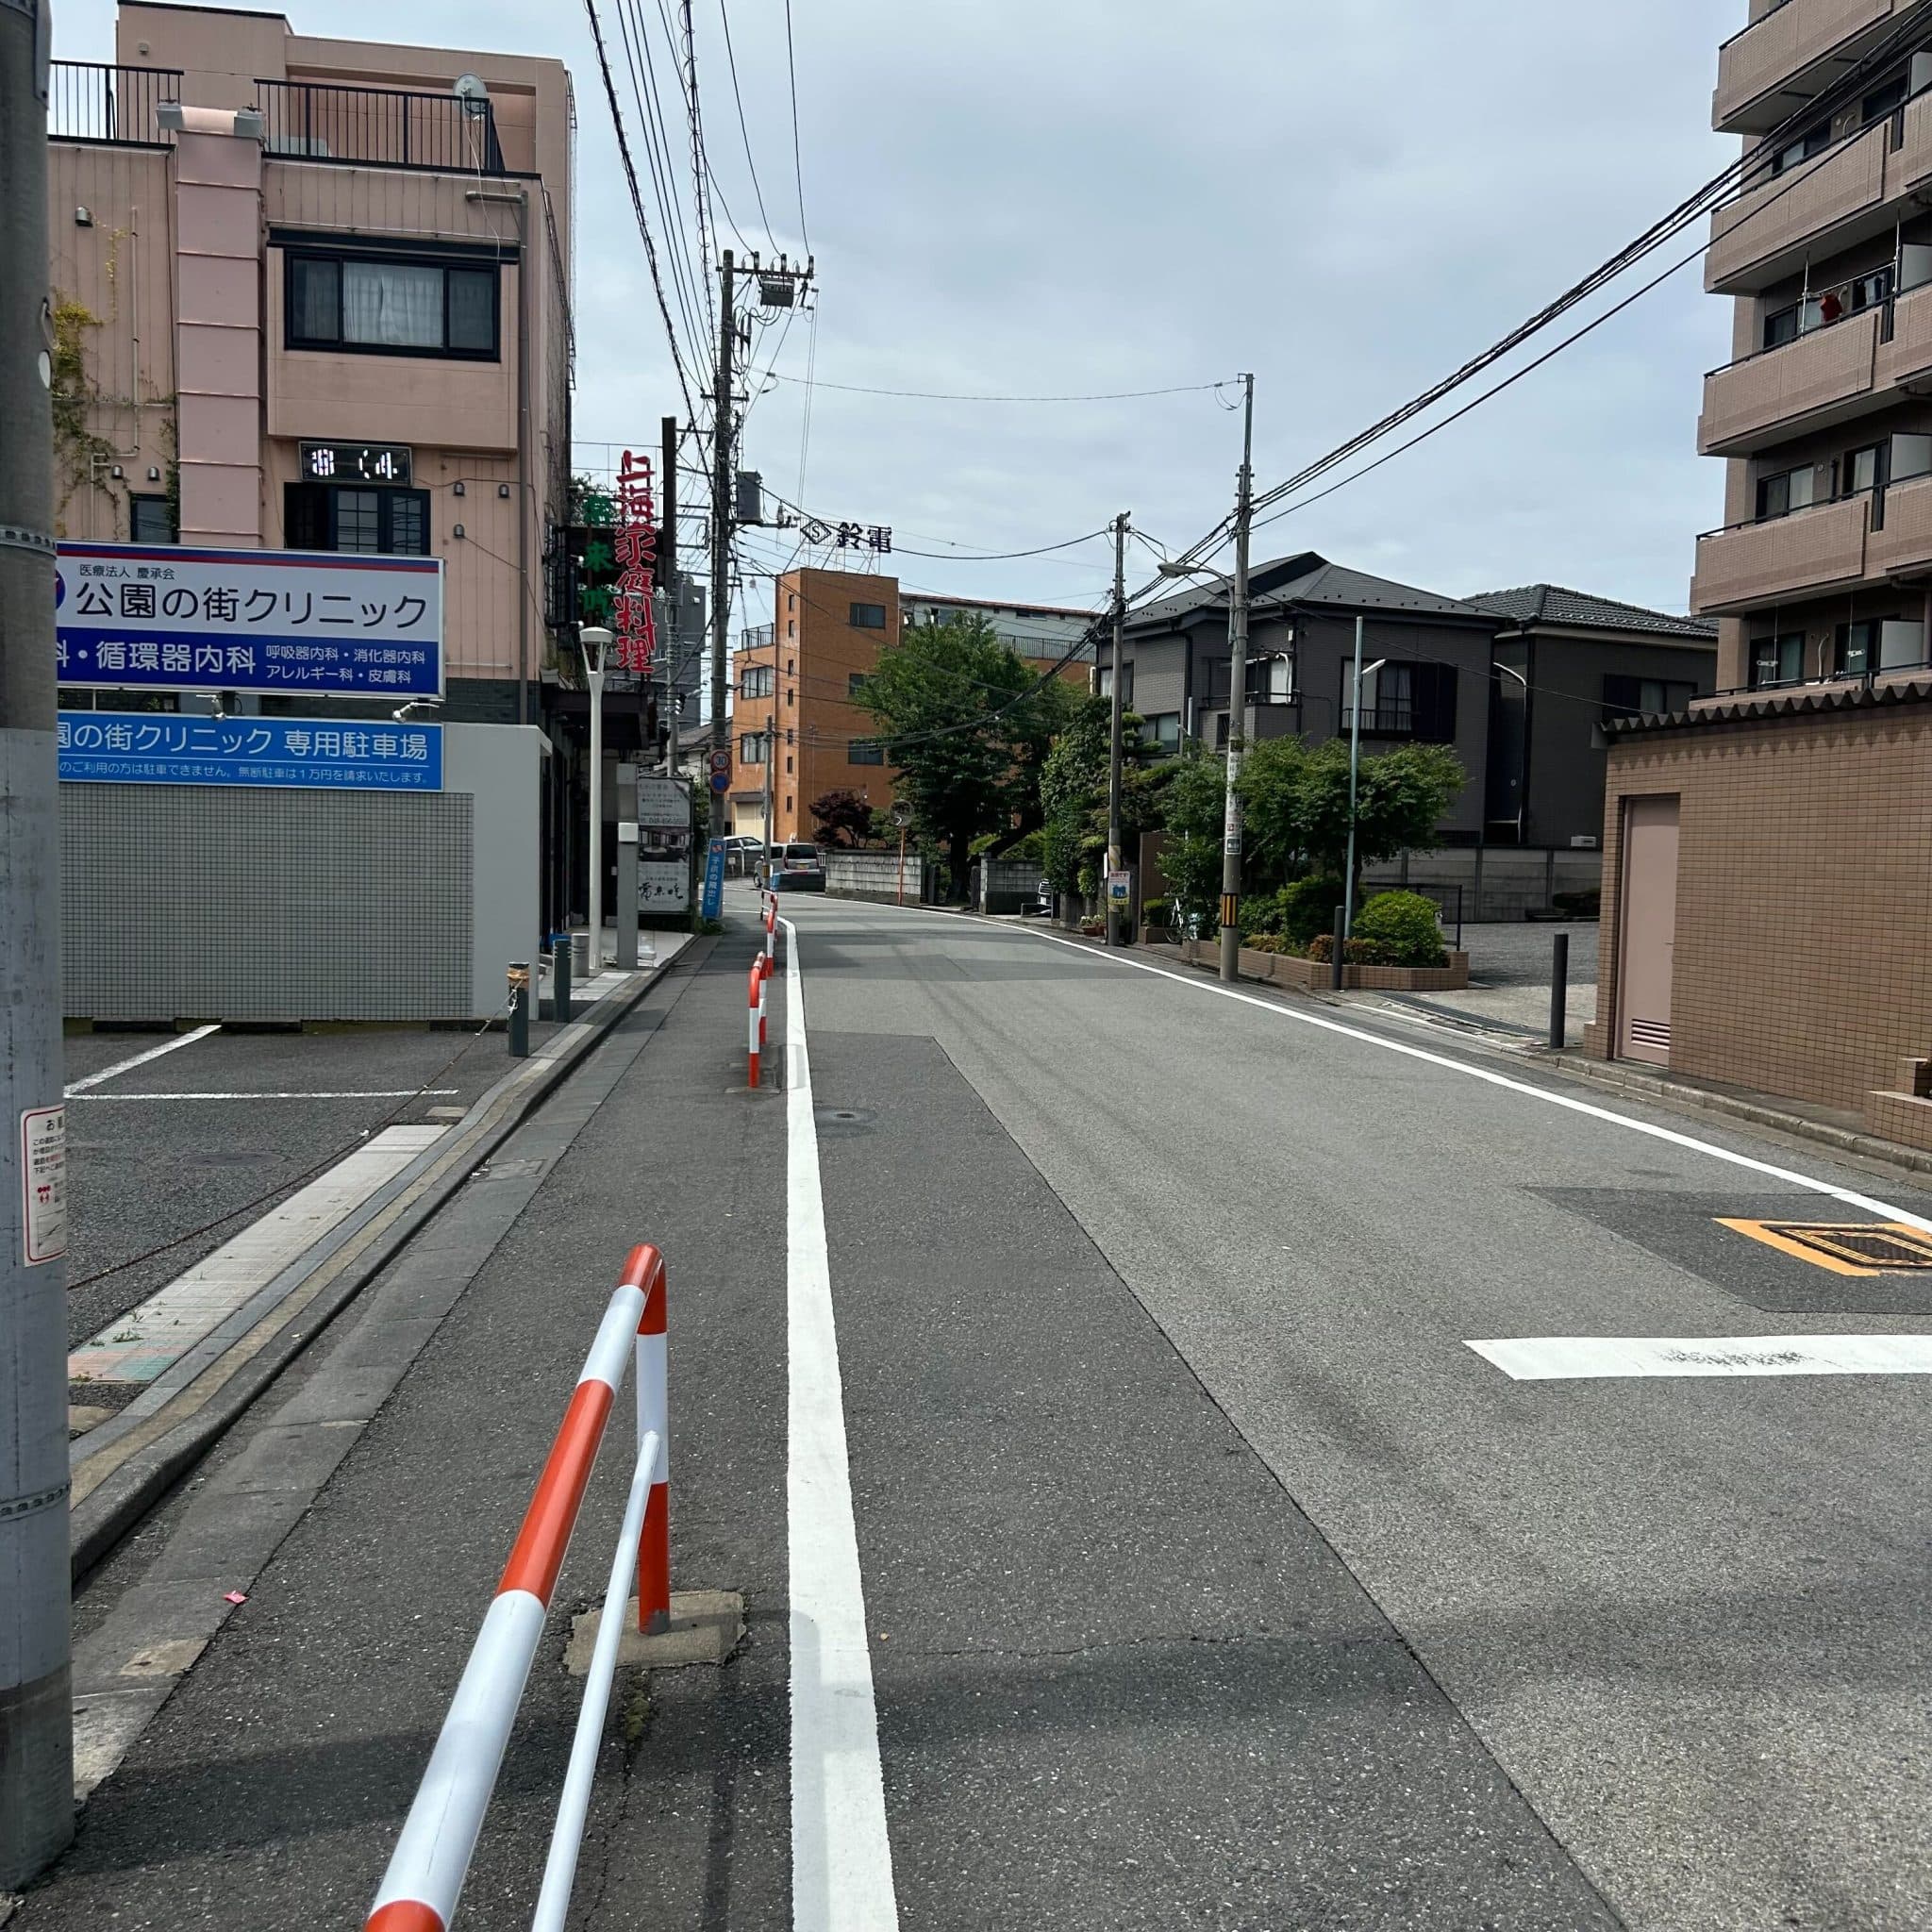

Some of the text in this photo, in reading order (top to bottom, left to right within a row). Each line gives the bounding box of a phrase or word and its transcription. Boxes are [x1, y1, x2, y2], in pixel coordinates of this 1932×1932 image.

[79, 564, 130, 578] 医療法人
[615, 449, 657, 673] 上海家庭料理
[76, 582, 426, 629] 公園の街クリニック
[265, 644, 425, 665] 呼吸器内科・消化器内科
[265, 664, 411, 685] アレルギー科・皮膚科
[284, 729, 428, 761] 専用駐車場
